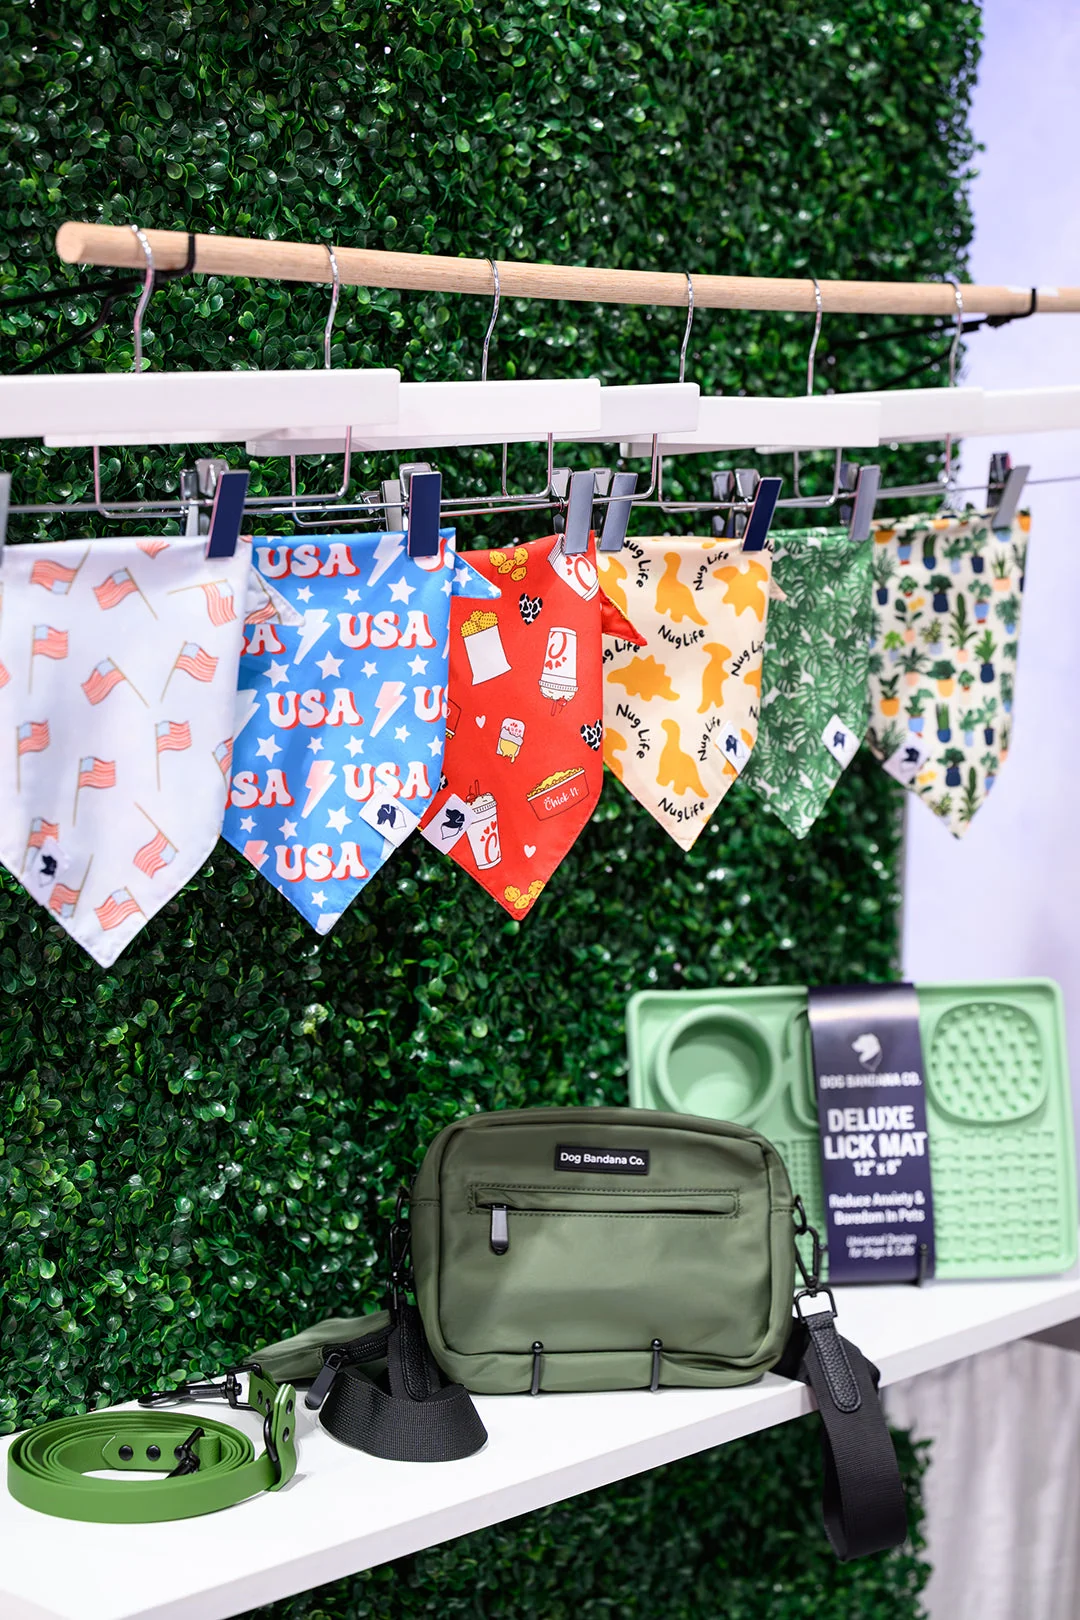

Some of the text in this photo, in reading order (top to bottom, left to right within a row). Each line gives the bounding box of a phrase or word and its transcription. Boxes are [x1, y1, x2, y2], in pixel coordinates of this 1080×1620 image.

[255, 543, 360, 579] USA
[636, 559, 651, 588] Life
[693, 551, 730, 591] Nug Life
[337, 610, 437, 649] USA
[658, 625, 706, 649] Nug Life
[731, 650, 750, 677] Nug
[265, 688, 364, 729] USA
[616, 704, 651, 759] Nug Life
[697, 716, 721, 761] Nug Life
[225, 769, 295, 809] SA
[342, 761, 433, 802] USA
[658, 797, 705, 823] Nug Life
[274, 841, 370, 882] USA
[827, 1105, 915, 1132] DELUXE
[560, 1152, 645, 1166] Dog Bandana Co.
[824, 1131, 928, 1160] LICK MAT
[829, 1193, 871, 1208] Reduce
[872, 1191, 914, 1208] Anxiety
[834, 1209, 885, 1225] Boredom
[898, 1207, 925, 1222] Pets
